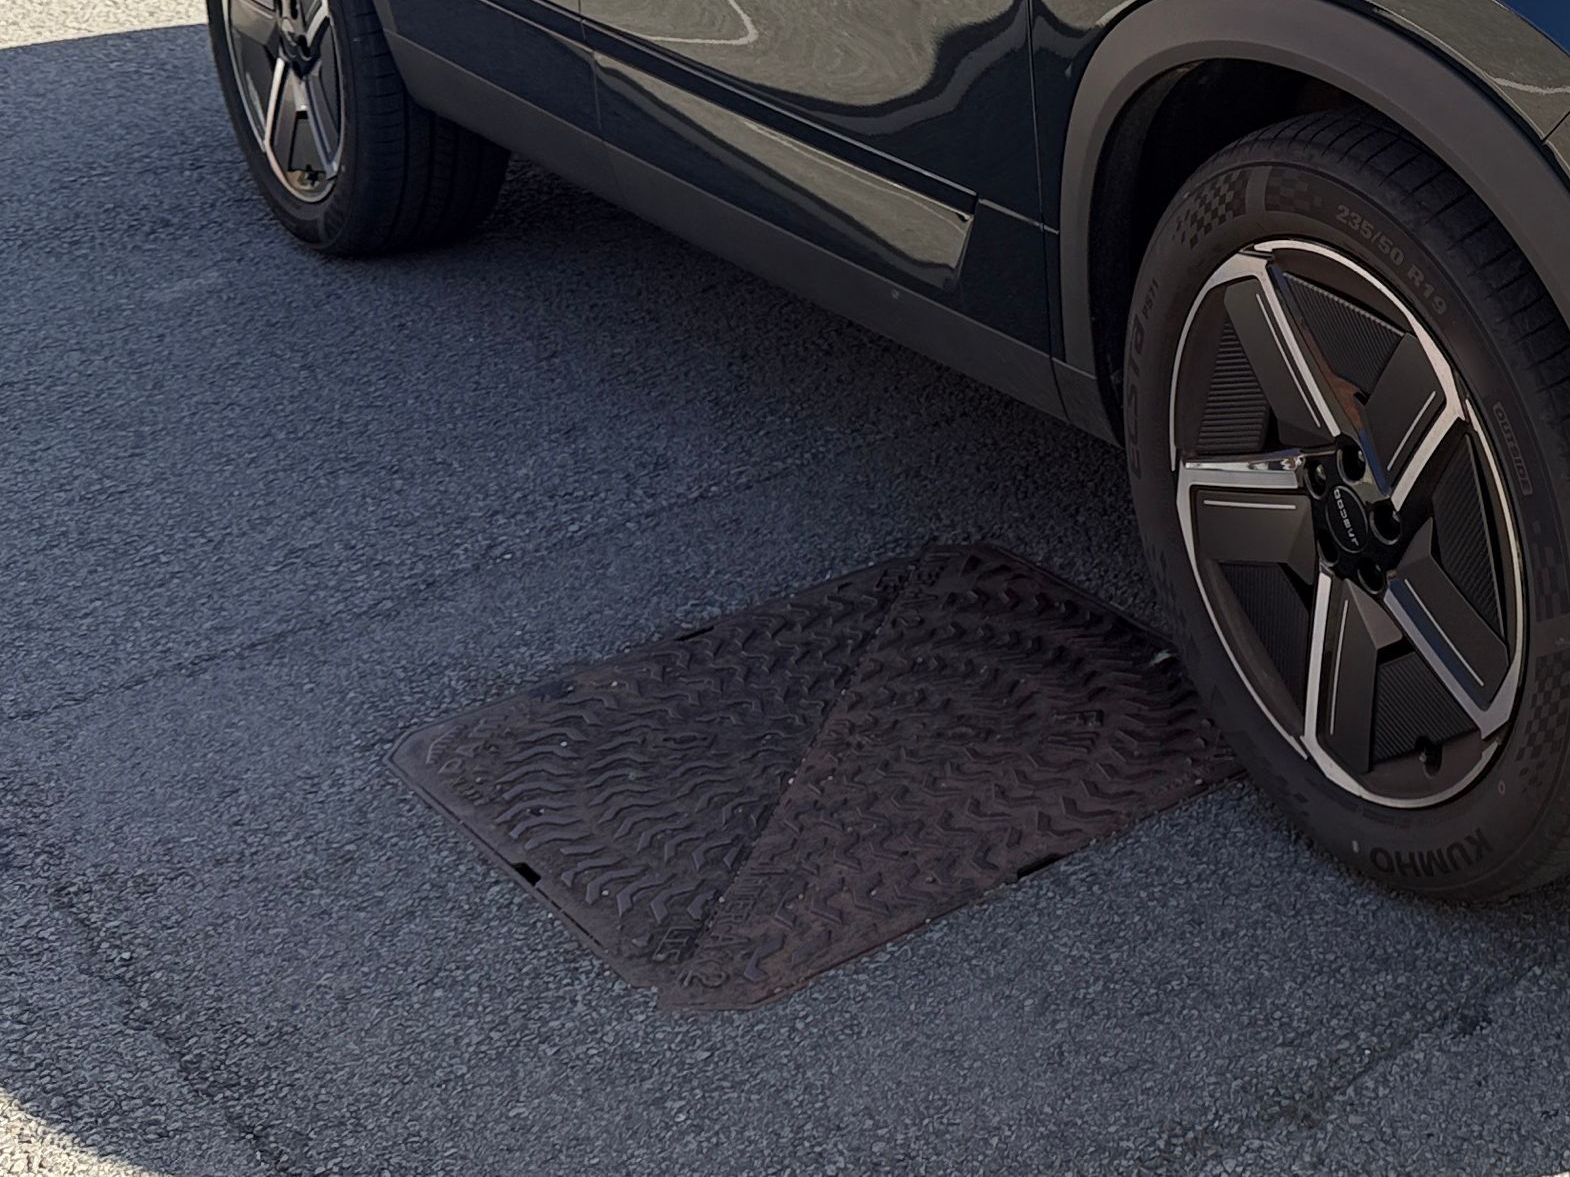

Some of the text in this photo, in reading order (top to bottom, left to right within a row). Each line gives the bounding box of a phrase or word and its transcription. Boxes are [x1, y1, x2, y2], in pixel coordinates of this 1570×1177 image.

[1335, 204, 1448, 315] 235/50 R19
[1496, 407, 1530, 491] OUTSIDE
[1369, 827, 1494, 878] KUMHO
